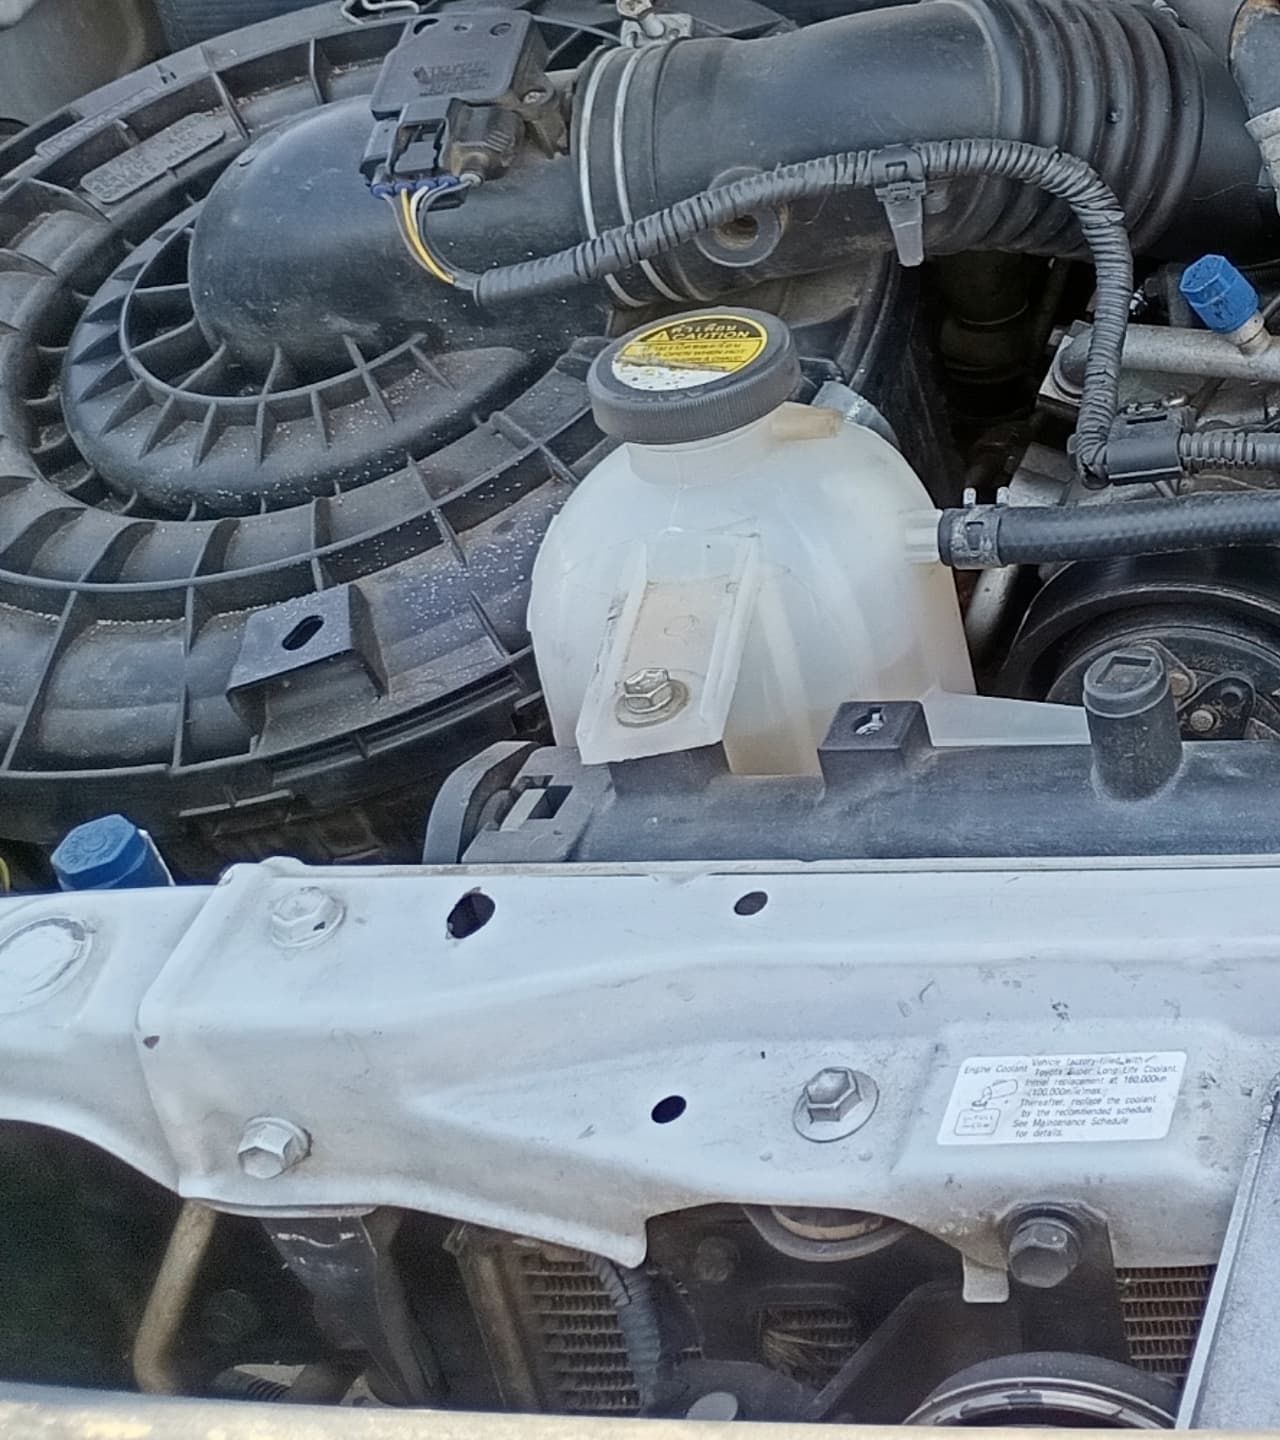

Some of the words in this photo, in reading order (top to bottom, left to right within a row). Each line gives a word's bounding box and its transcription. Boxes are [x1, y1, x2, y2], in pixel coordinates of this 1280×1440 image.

[672, 331, 750, 341] CAUTION
[964, 1065, 991, 1075] Engine
[995, 1064, 1028, 1073] Coolant
[1034, 1068, 1063, 1077] Toyota
[1054, 1077, 1104, 1086] replacement
[1070, 1097, 1102, 1107] replace
[1124, 1095, 1156, 1105] coolant
[1031, 1118, 1086, 1128] Maintenance
[1090, 1116, 1128, 1126] Schedule
